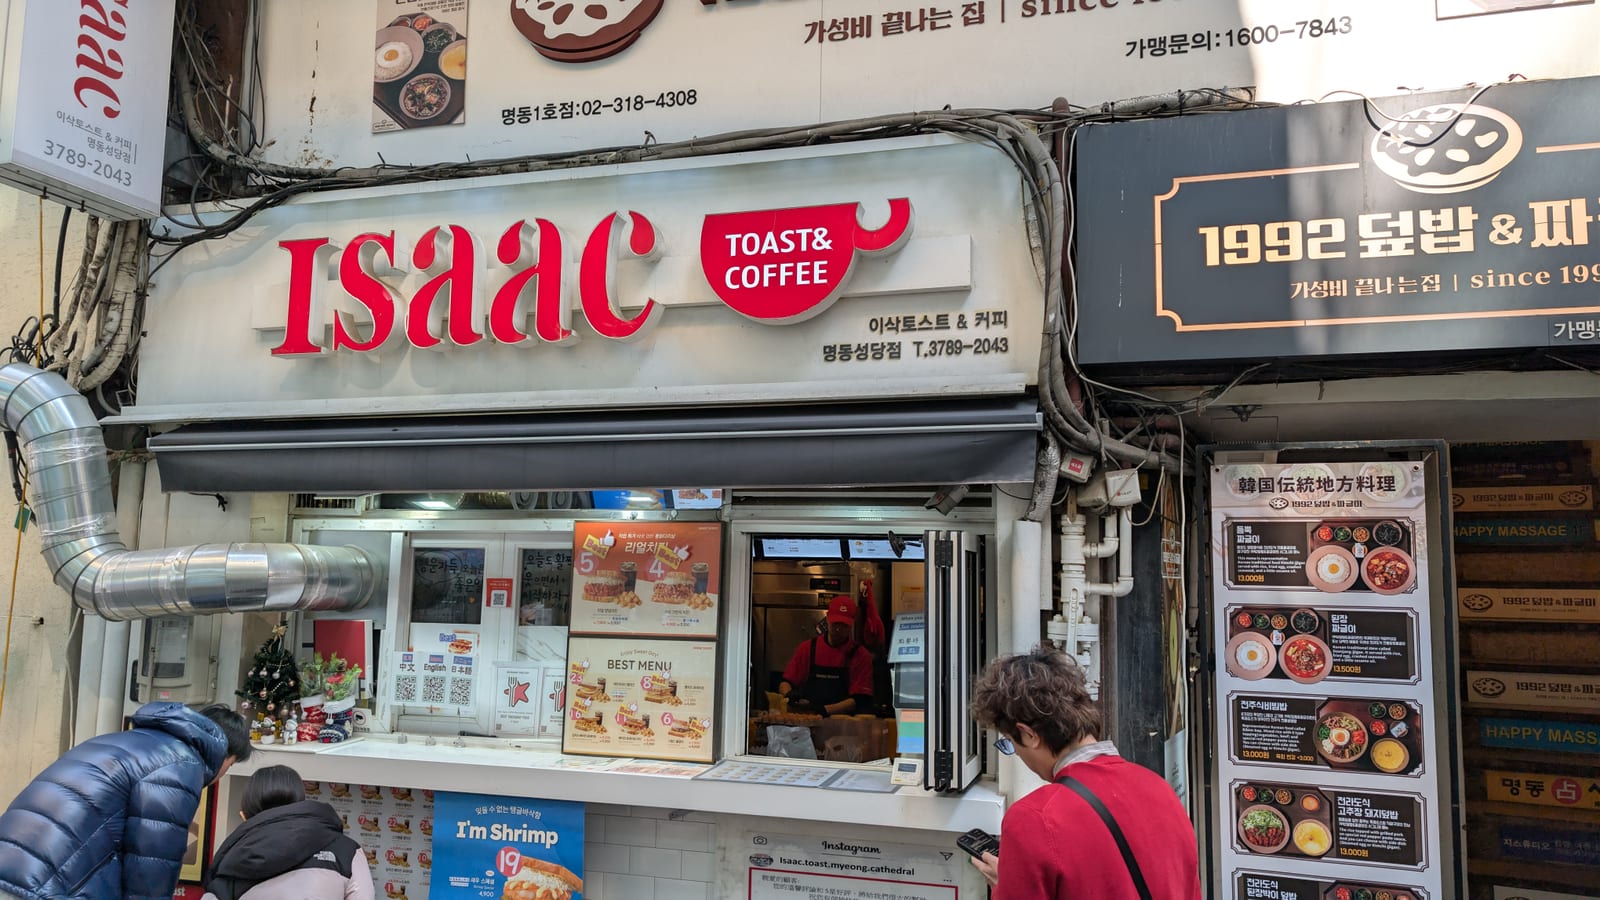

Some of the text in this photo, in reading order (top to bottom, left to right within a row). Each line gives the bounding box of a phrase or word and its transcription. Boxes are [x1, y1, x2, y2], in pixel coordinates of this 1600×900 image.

[805, 15, 872, 44] 가성비
[881, 7, 952, 37] 끝나는
[962, 1, 985, 26] 집
[1126, 16, 1352, 58] 가맹문의:1600-7843
[501, 90, 697, 125] 명동1호점:02-318-4308
[56, 110, 132, 149] 이삭토스트 & 커피
[87, 136, 131, 164] 명동성당점
[44, 140, 132, 187] 3789-2043
[1199, 197, 1600, 266] 1992 덮밥 & 짜
[725, 226, 833, 257] TOAST&
[271, 210, 657, 357] Isaac
[725, 260, 829, 290] COFFEE
[1290, 280, 1347, 299] 가성비
[1470, 268, 1550, 289] since
[868, 309, 1009, 334] 이삭토스트 & 커피
[1554, 320, 1600, 340] 가맹
[823, 336, 1009, 363] 명동성당점 T.3789-2043
[1238, 476, 1396, 494] 韓国伝統地方料理
[1292, 500, 1312, 508] 1992
[1314, 500, 1330, 508] 덮밥
[1498, 525, 1567, 536] MASSAGE
[625, 541, 668, 554] 리얼치
[580, 552, 594, 573] 5
[650, 557, 664, 578] 4
[1503, 597, 1530, 605] 1992
[1331, 614, 1348, 624] 된장
[1332, 624, 1356, 634] 짜글이
[400, 664, 415, 672] 中文
[424, 664, 446, 673] English
[451, 666, 472, 675] 日本語
[607, 659, 672, 672] BEST MENU
[643, 676, 651, 689] 8
[1516, 681, 1546, 691] 1992
[1548, 682, 1572, 693] 덮밥
[664, 714, 670, 724] 6
[1486, 724, 1543, 742] HAPPY
[1501, 777, 1544, 798] 명동
[1337, 796, 1370, 808] 전라도식
[1338, 806, 1363, 817] 고추장
[456, 820, 559, 849] I'm Shrimp
[822, 840, 881, 856] Instagram
[500, 850, 521, 875] 19
[1246, 877, 1278, 890] 전라도식
